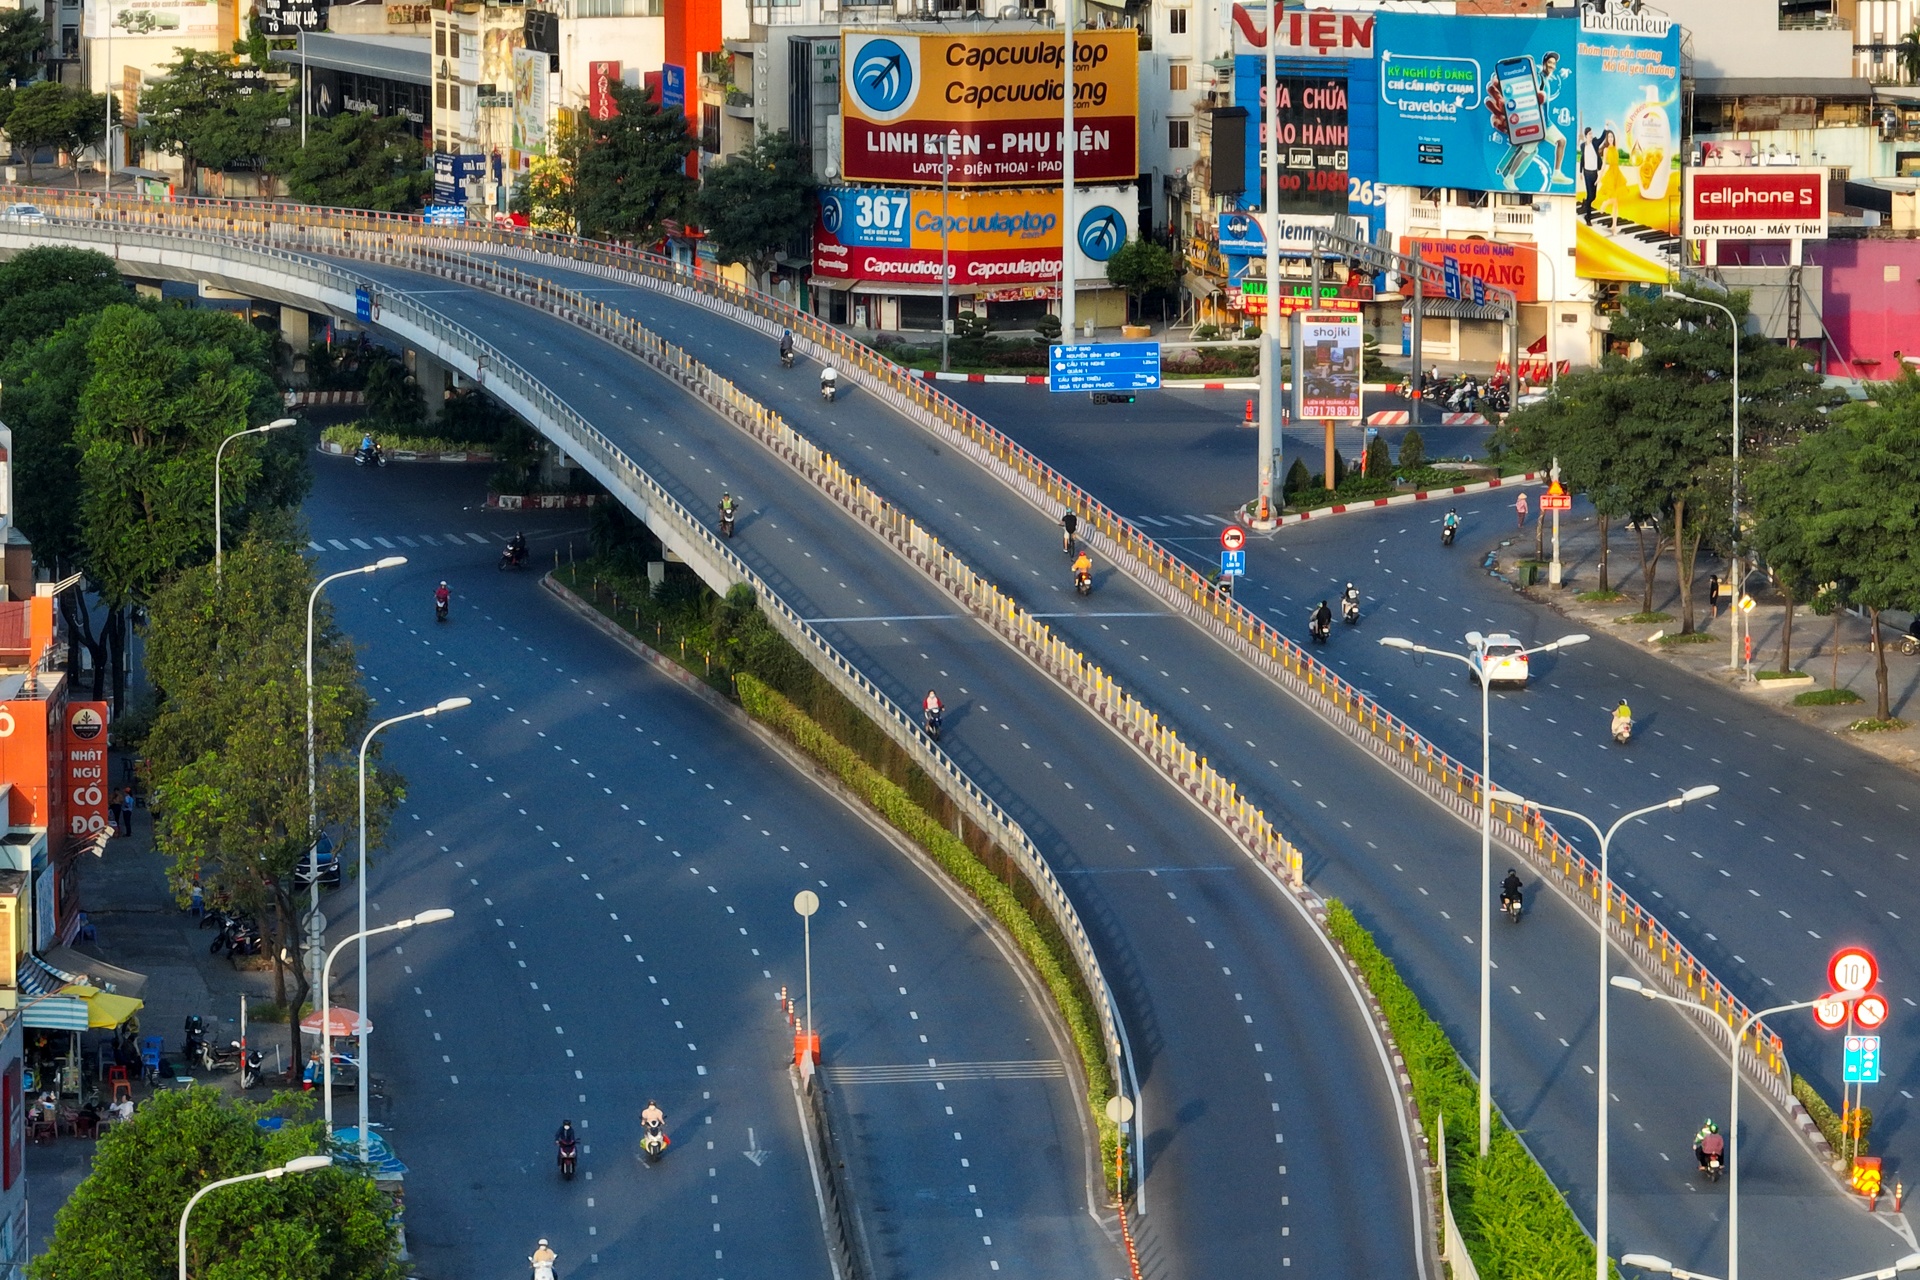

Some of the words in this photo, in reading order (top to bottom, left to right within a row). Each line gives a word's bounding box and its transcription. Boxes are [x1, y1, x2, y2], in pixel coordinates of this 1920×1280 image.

[282, 5, 302, 26] THỦY
[303, 7, 318, 28] LỰC
[1233, 1, 1374, 54] VIỆN
[1582, 2, 1670, 34] Enchanteur
[945, 40, 1108, 72] Capcuulaptop
[945, 79, 1108, 109] Capcuudidong
[1303, 81, 1347, 110] CHỮA
[1425, 81, 1446, 94] MỘT
[1398, 98, 1456, 114] traveloka
[1302, 117, 1348, 146] HÀNH
[867, 131, 918, 153] LINH
[1002, 132, 1051, 158] PHỤ
[913, 162, 953, 175] LAPTOP
[963, 161, 992, 177] ĐIỆN
[995, 161, 1028, 176] THOẠI
[1037, 160, 1062, 172] IPAD
[1291, 154, 1312, 165] LAPTOP
[1317, 155, 1336, 166] TABLET
[1307, 170, 1348, 192] 1080
[1348, 177, 1386, 206] 265
[1699, 187, 1794, 208] cellphone
[856, 195, 908, 229] 367
[914, 209, 1057, 238] Capcuulaptop
[1693, 223, 1719, 237] ĐIỆN
[1723, 225, 1756, 237] THOẠI
[1767, 223, 1791, 234] MÁY
[1795, 223, 1821, 234] TÍNH
[1436, 242, 1456, 255] TÙNG
[864, 256, 956, 280] Capcuudidong
[967, 258, 1063, 279] Capcuulaptop
[1460, 259, 1525, 286] HOÀNG
[1313, 327, 1351, 339] shojiki
[1303, 405, 1323, 417] 0971
[1325, 405, 1335, 416] 79
[1337, 405, 1347, 416] 89
[1349, 404, 1359, 416] 79
[71, 748, 103, 762] NHẬT
[73, 765, 101, 778] NGỮ
[73, 779, 102, 806] CỐ
[71, 810, 105, 834] ĐÔ
[1843, 964, 1859, 985] 10
[1824, 1004, 1839, 1018] 50
